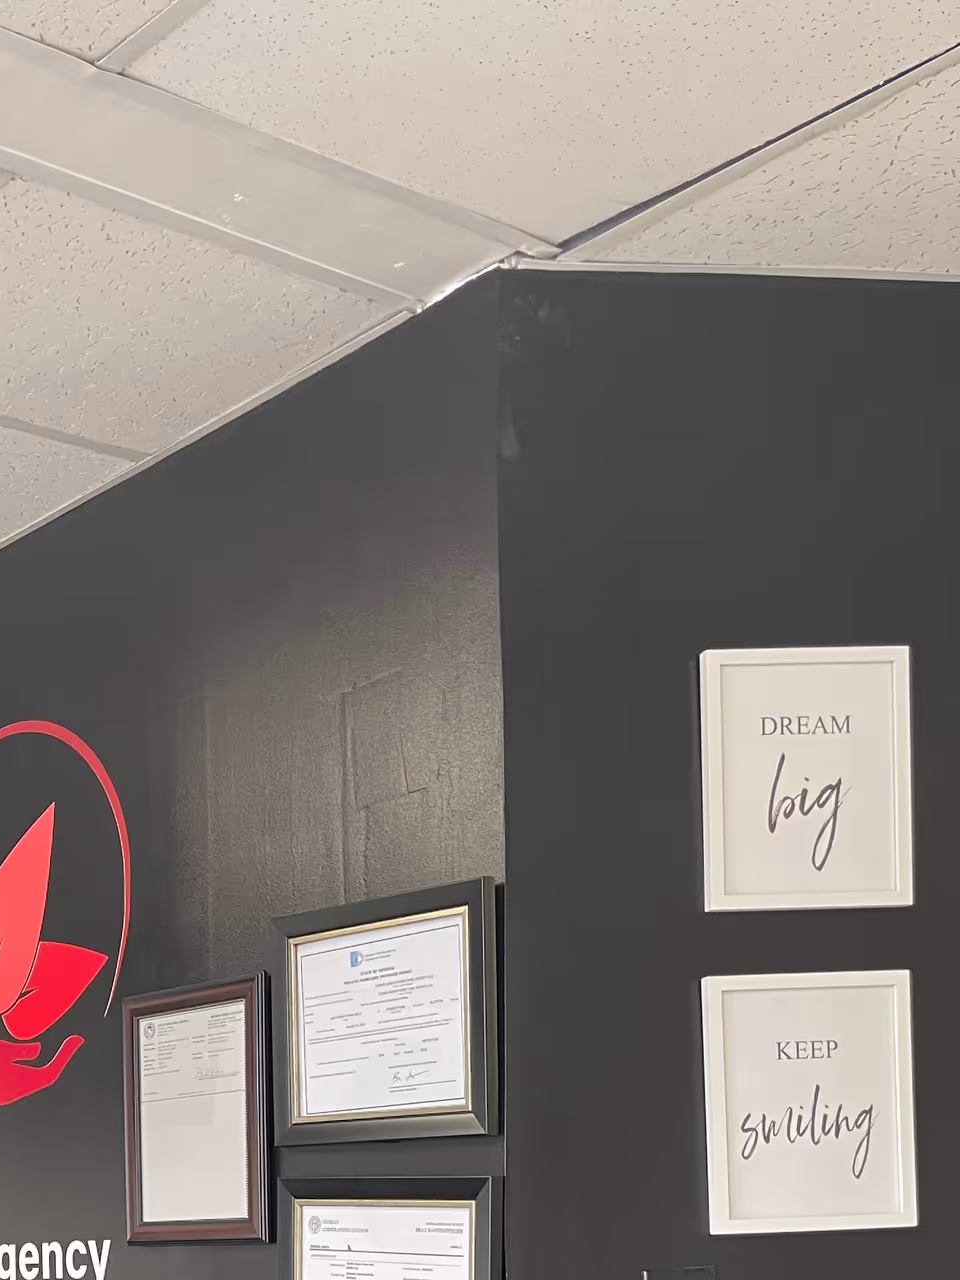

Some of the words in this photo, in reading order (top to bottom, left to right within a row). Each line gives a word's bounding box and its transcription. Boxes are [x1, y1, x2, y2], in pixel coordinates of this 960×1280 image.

[760, 714, 852, 737] DREAM
[767, 751, 852, 872] big
[775, 1040, 839, 1061] KEEP
[739, 1083, 880, 1180] smiling
